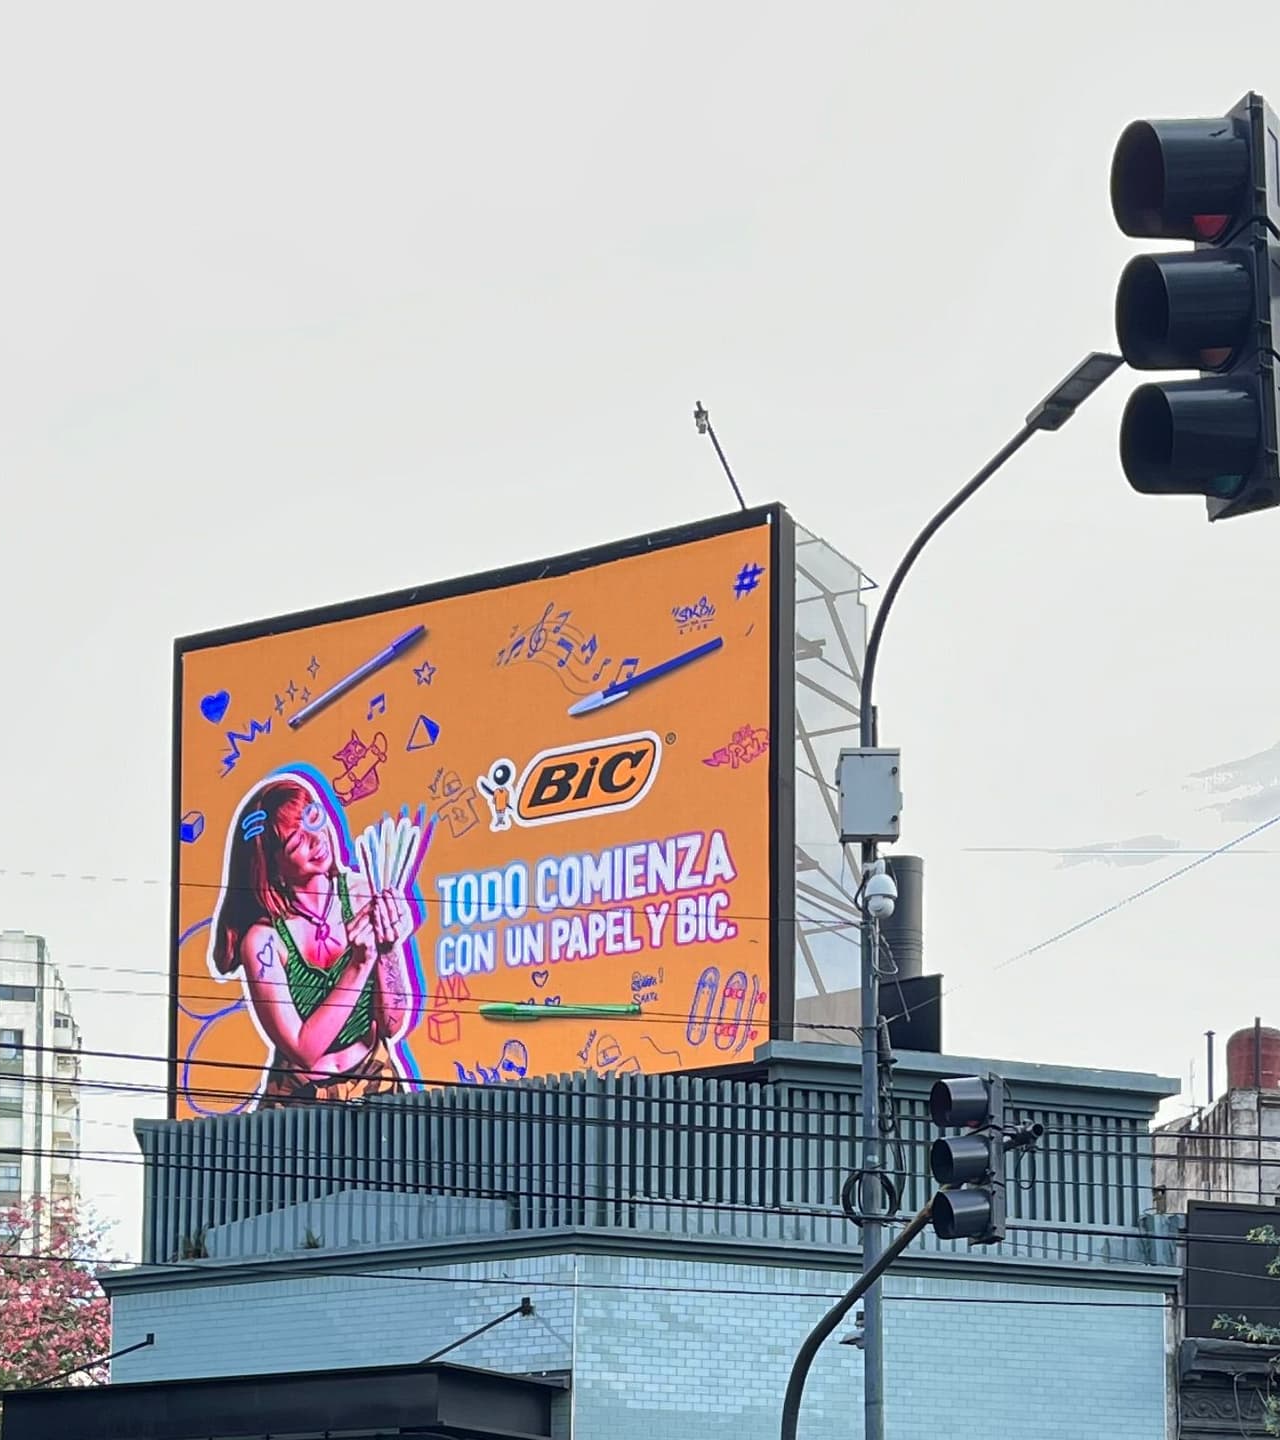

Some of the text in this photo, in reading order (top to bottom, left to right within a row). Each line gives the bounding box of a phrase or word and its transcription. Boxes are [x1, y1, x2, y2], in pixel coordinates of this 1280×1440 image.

[437, 831, 736, 927] TODO COMIENZA
[439, 893, 736, 977] CON UN PAPEL Y BIC.
